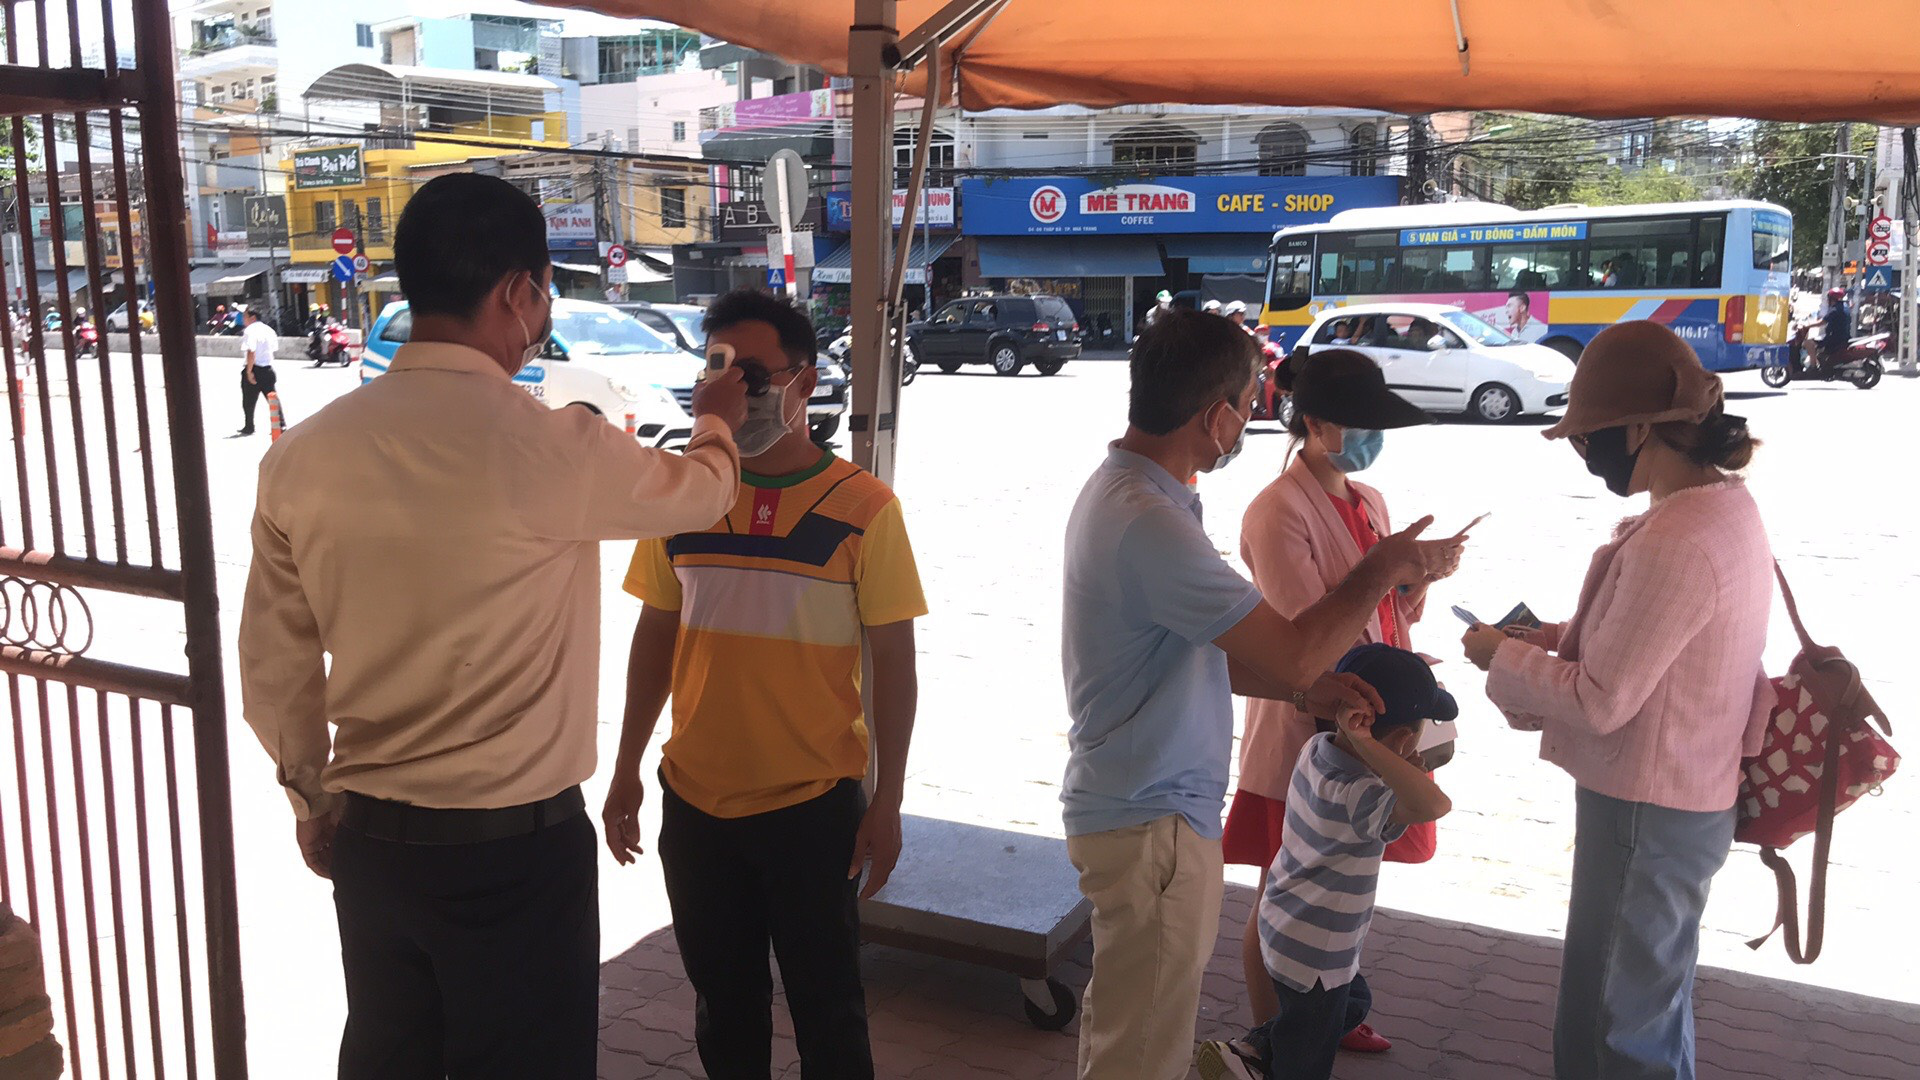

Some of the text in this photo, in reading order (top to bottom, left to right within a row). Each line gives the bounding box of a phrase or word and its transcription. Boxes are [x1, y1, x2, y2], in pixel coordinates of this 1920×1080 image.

[1124, 193, 1189, 211] TRANG
[1217, 193, 1265, 213] CAFE
[1284, 193, 1335, 213] SHOP
[571, 216, 592, 228] ANH
[1121, 215, 1155, 225] COFFEE
[1470, 229, 1483, 241] TU
[1485, 227, 1514, 240] BÔNG
[1550, 224, 1577, 238] MÔN
